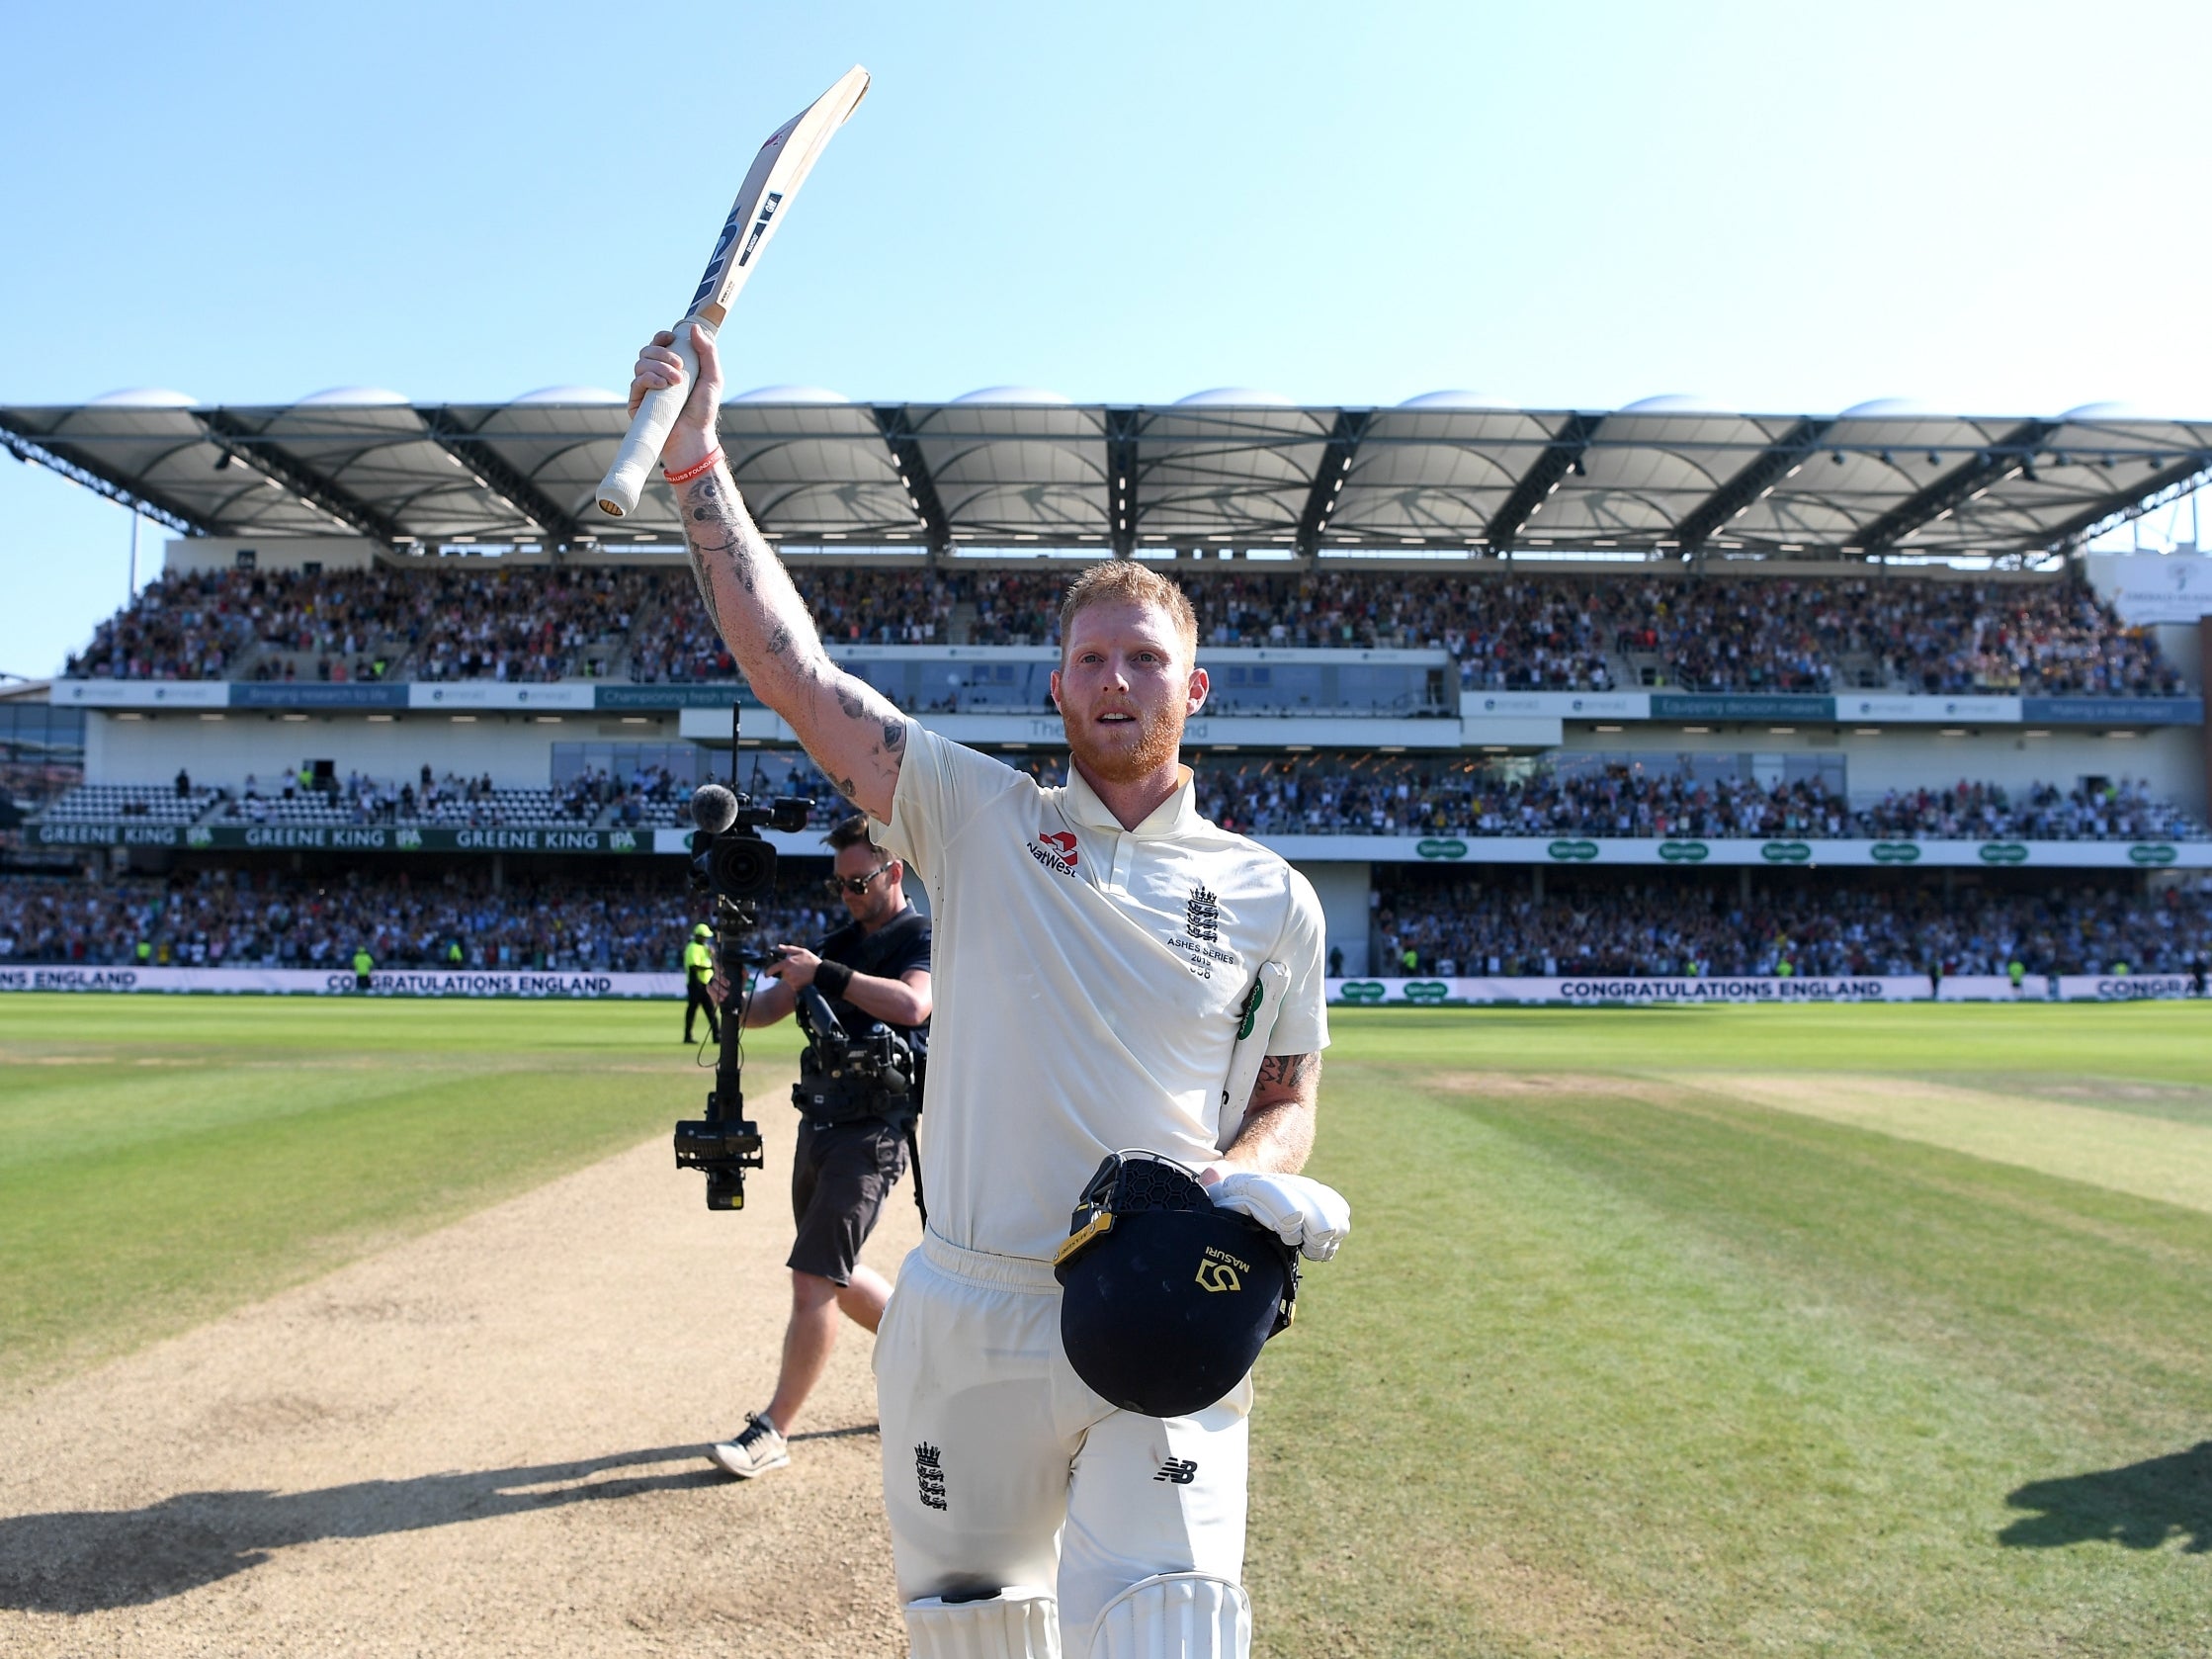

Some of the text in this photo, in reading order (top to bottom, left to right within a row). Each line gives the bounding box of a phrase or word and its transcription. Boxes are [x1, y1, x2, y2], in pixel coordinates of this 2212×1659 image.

[39, 827, 119, 844] GREENE
[124, 828, 177, 845] KING
[245, 828, 322, 846] GREENE
[329, 829, 385, 847] KING
[457, 830, 536, 848] GREENE
[543, 831, 599, 849] KING
[1027, 841, 1076, 878] NatWest
[1167, 937, 1234, 965] ASHES SERIES
[35, 972, 137, 987] ENGLAND
[327, 975, 612, 993] COGRATULATIONS ENGLAND
[1562, 982, 1883, 998] CONGRATULATIONS ENGLAND
[1205, 1246, 1250, 1273] MASURI
